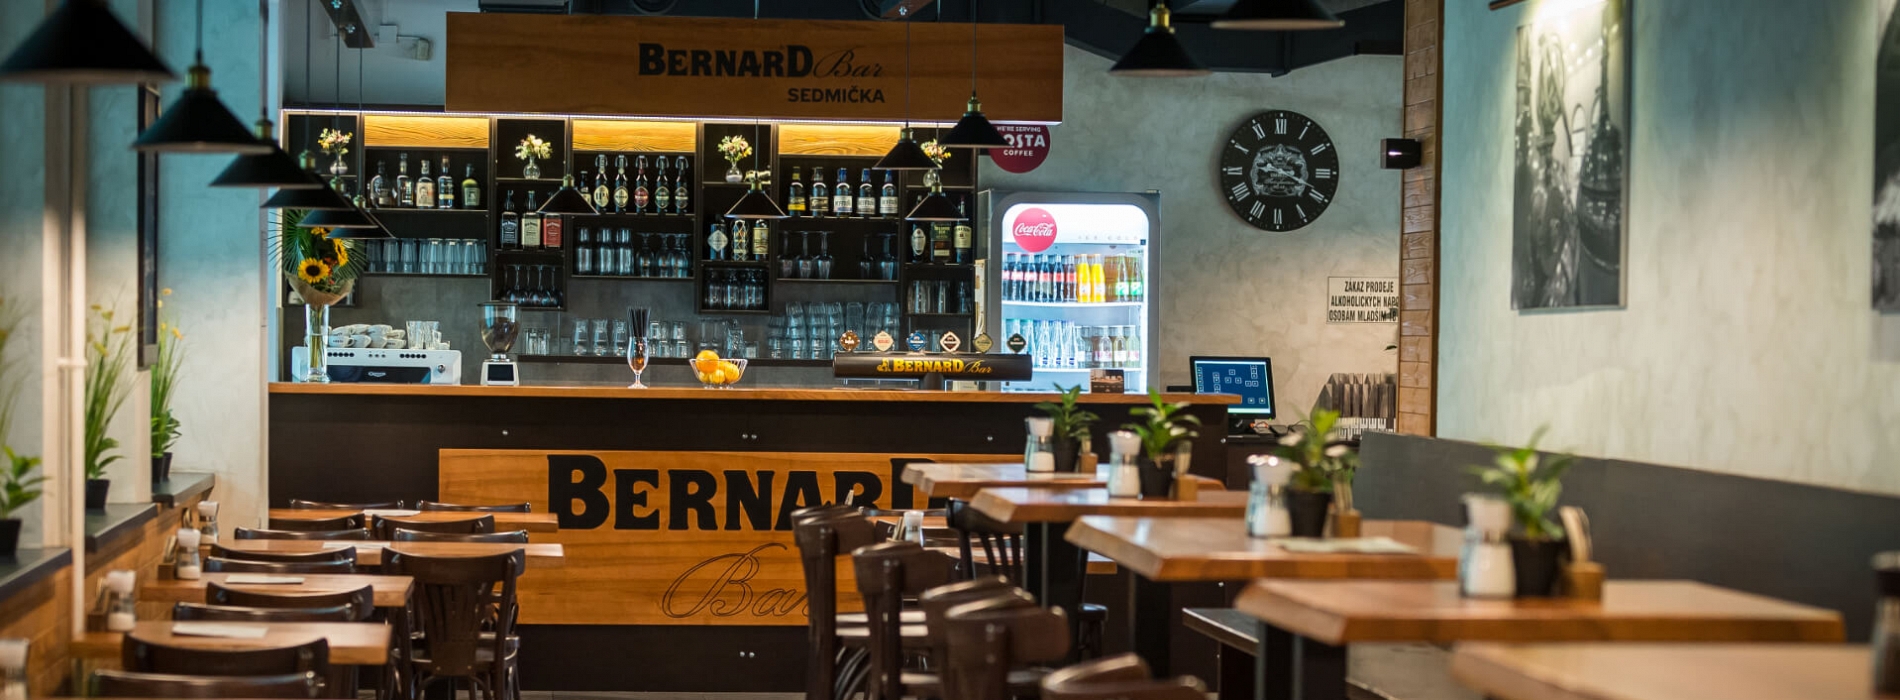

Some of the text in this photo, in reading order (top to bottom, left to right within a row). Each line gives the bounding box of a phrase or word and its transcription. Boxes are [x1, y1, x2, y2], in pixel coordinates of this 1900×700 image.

[638, 42, 885, 78] BERNARD Bar
[788, 85, 886, 103] SEDMIČKA
[1274, 118, 1287, 135] XII
[1003, 134, 1046, 148] OSTA
[1015, 223, 1055, 237] Coca-Cola
[1365, 281, 1394, 292] PRODEJE
[893, 358, 993, 374] BERNARD Bar
[661, 542, 808, 619] Ba
